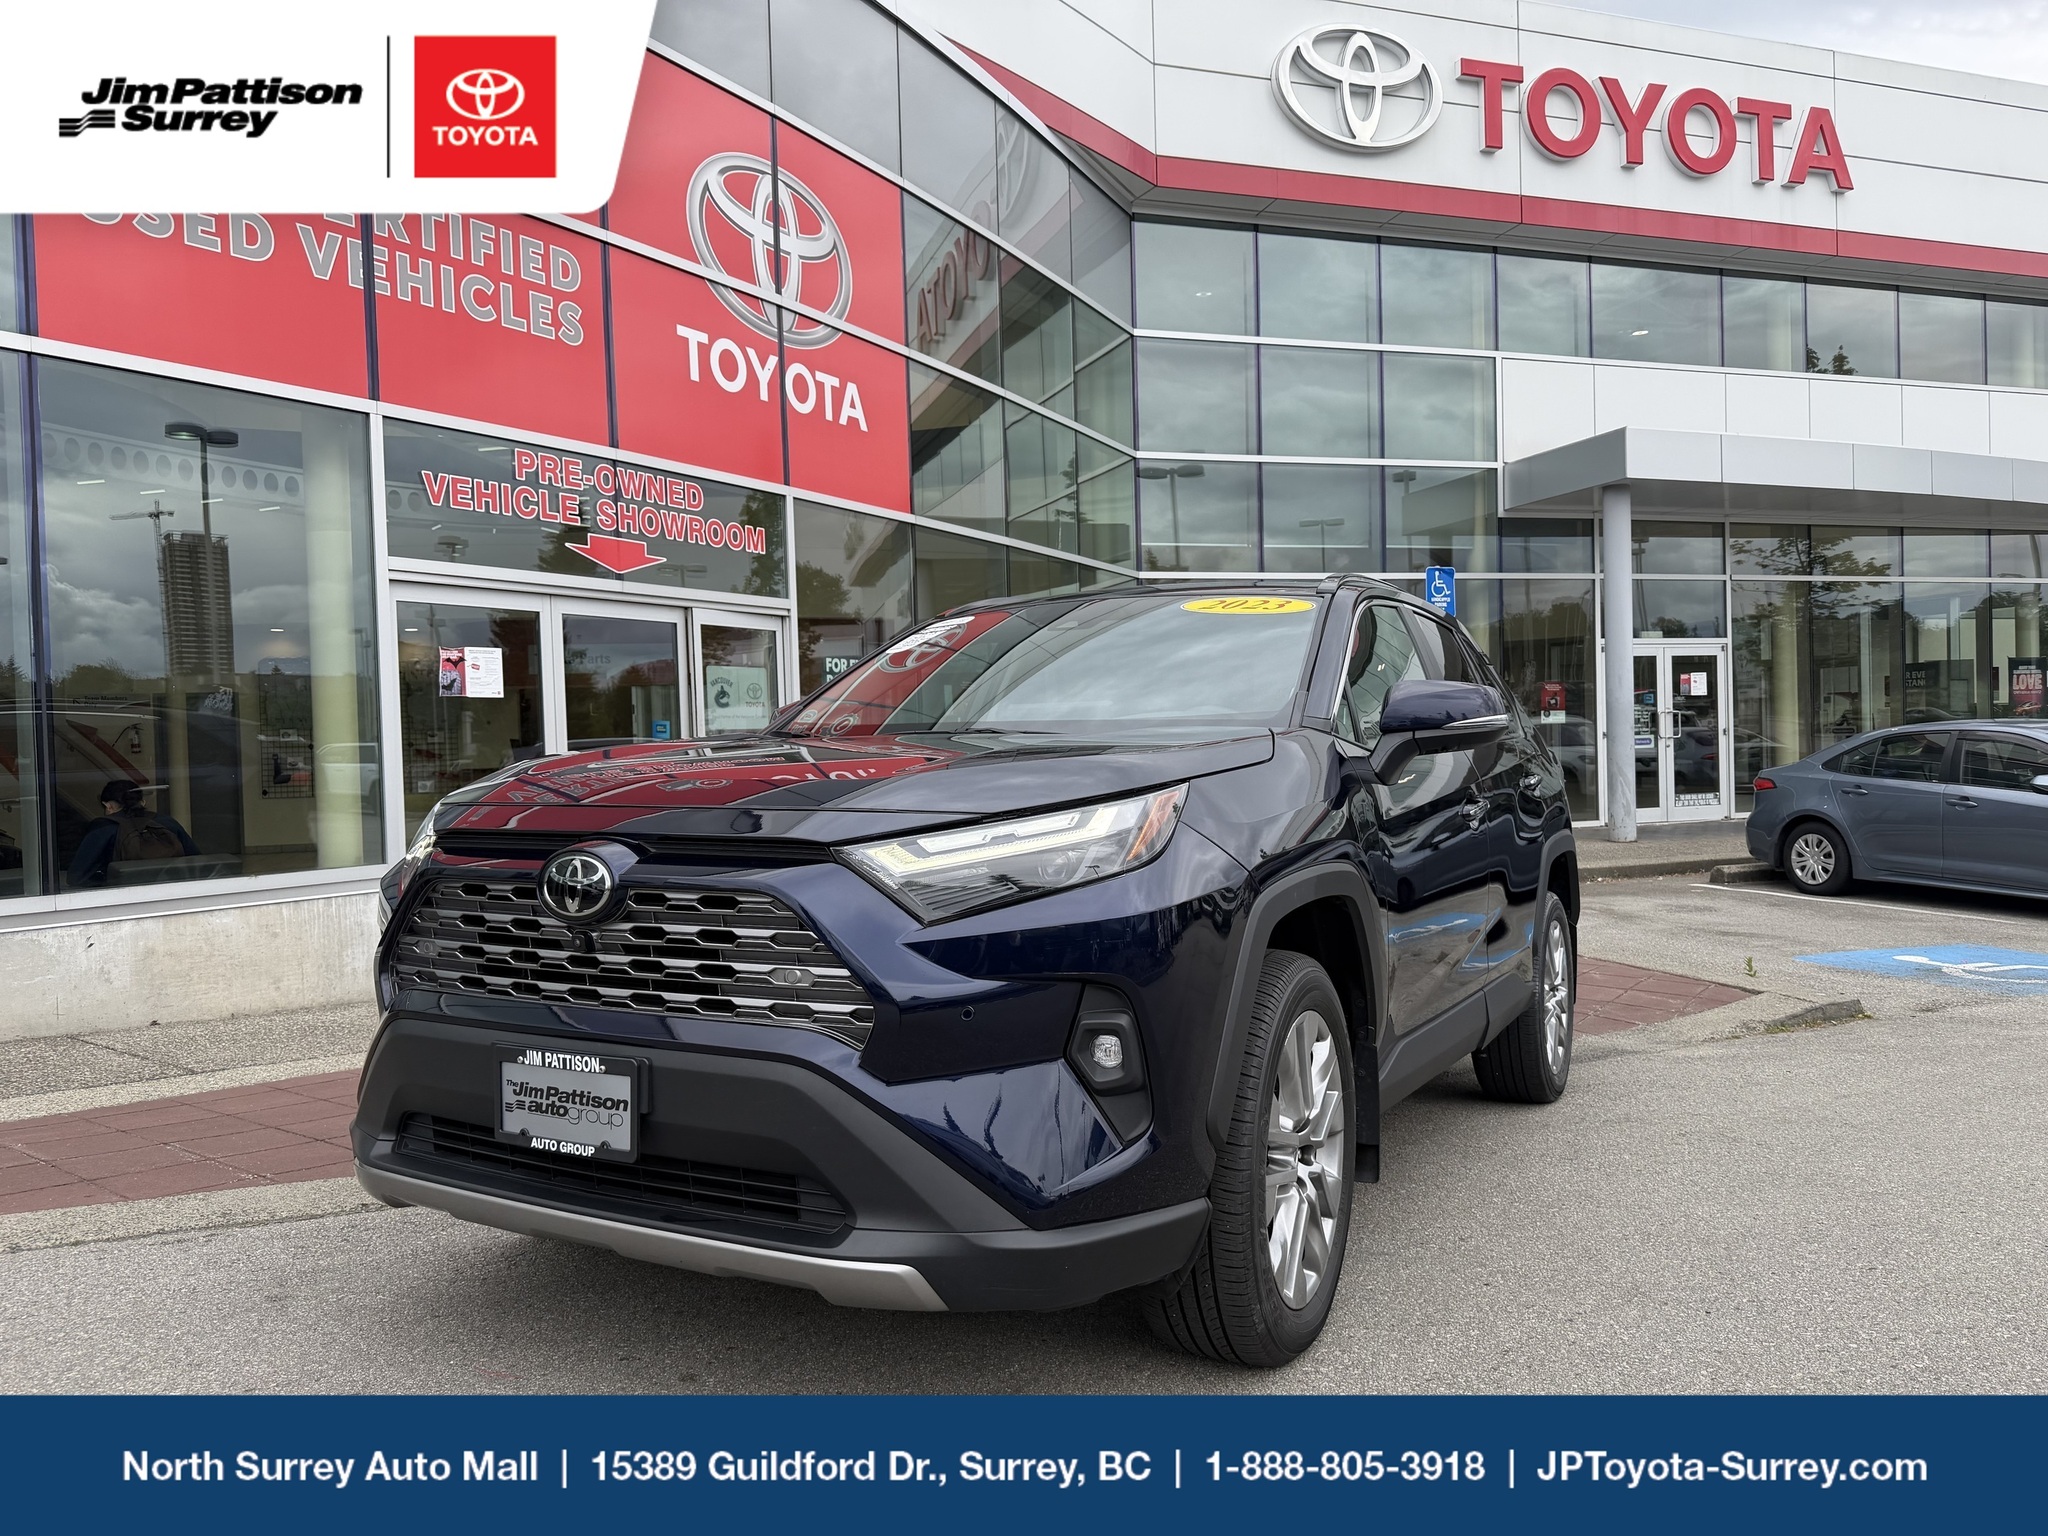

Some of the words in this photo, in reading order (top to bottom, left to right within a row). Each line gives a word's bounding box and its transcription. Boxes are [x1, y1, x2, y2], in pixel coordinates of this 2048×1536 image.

[1455, 57, 1854, 194] TOYOTA
[80, 213, 275, 262] SED
[295, 222, 584, 346] VEHICLES
[676, 324, 868, 432] TOYOTA
[514, 448, 704, 512] PRE-OWNED
[421, 470, 581, 525] VEHICLE
[597, 499, 767, 554] SHOWROOM
[1198, 600, 1292, 610] 2023
[825, 657, 848, 672] FOR
[2012, 674, 2043, 690] LOVE
[524, 1050, 542, 1066] JIM
[545, 1053, 600, 1073] PATTISON
[506, 1079, 519, 1087] The
[531, 1137, 557, 1151] AUTO
[560, 1141, 595, 1157] GROUP
